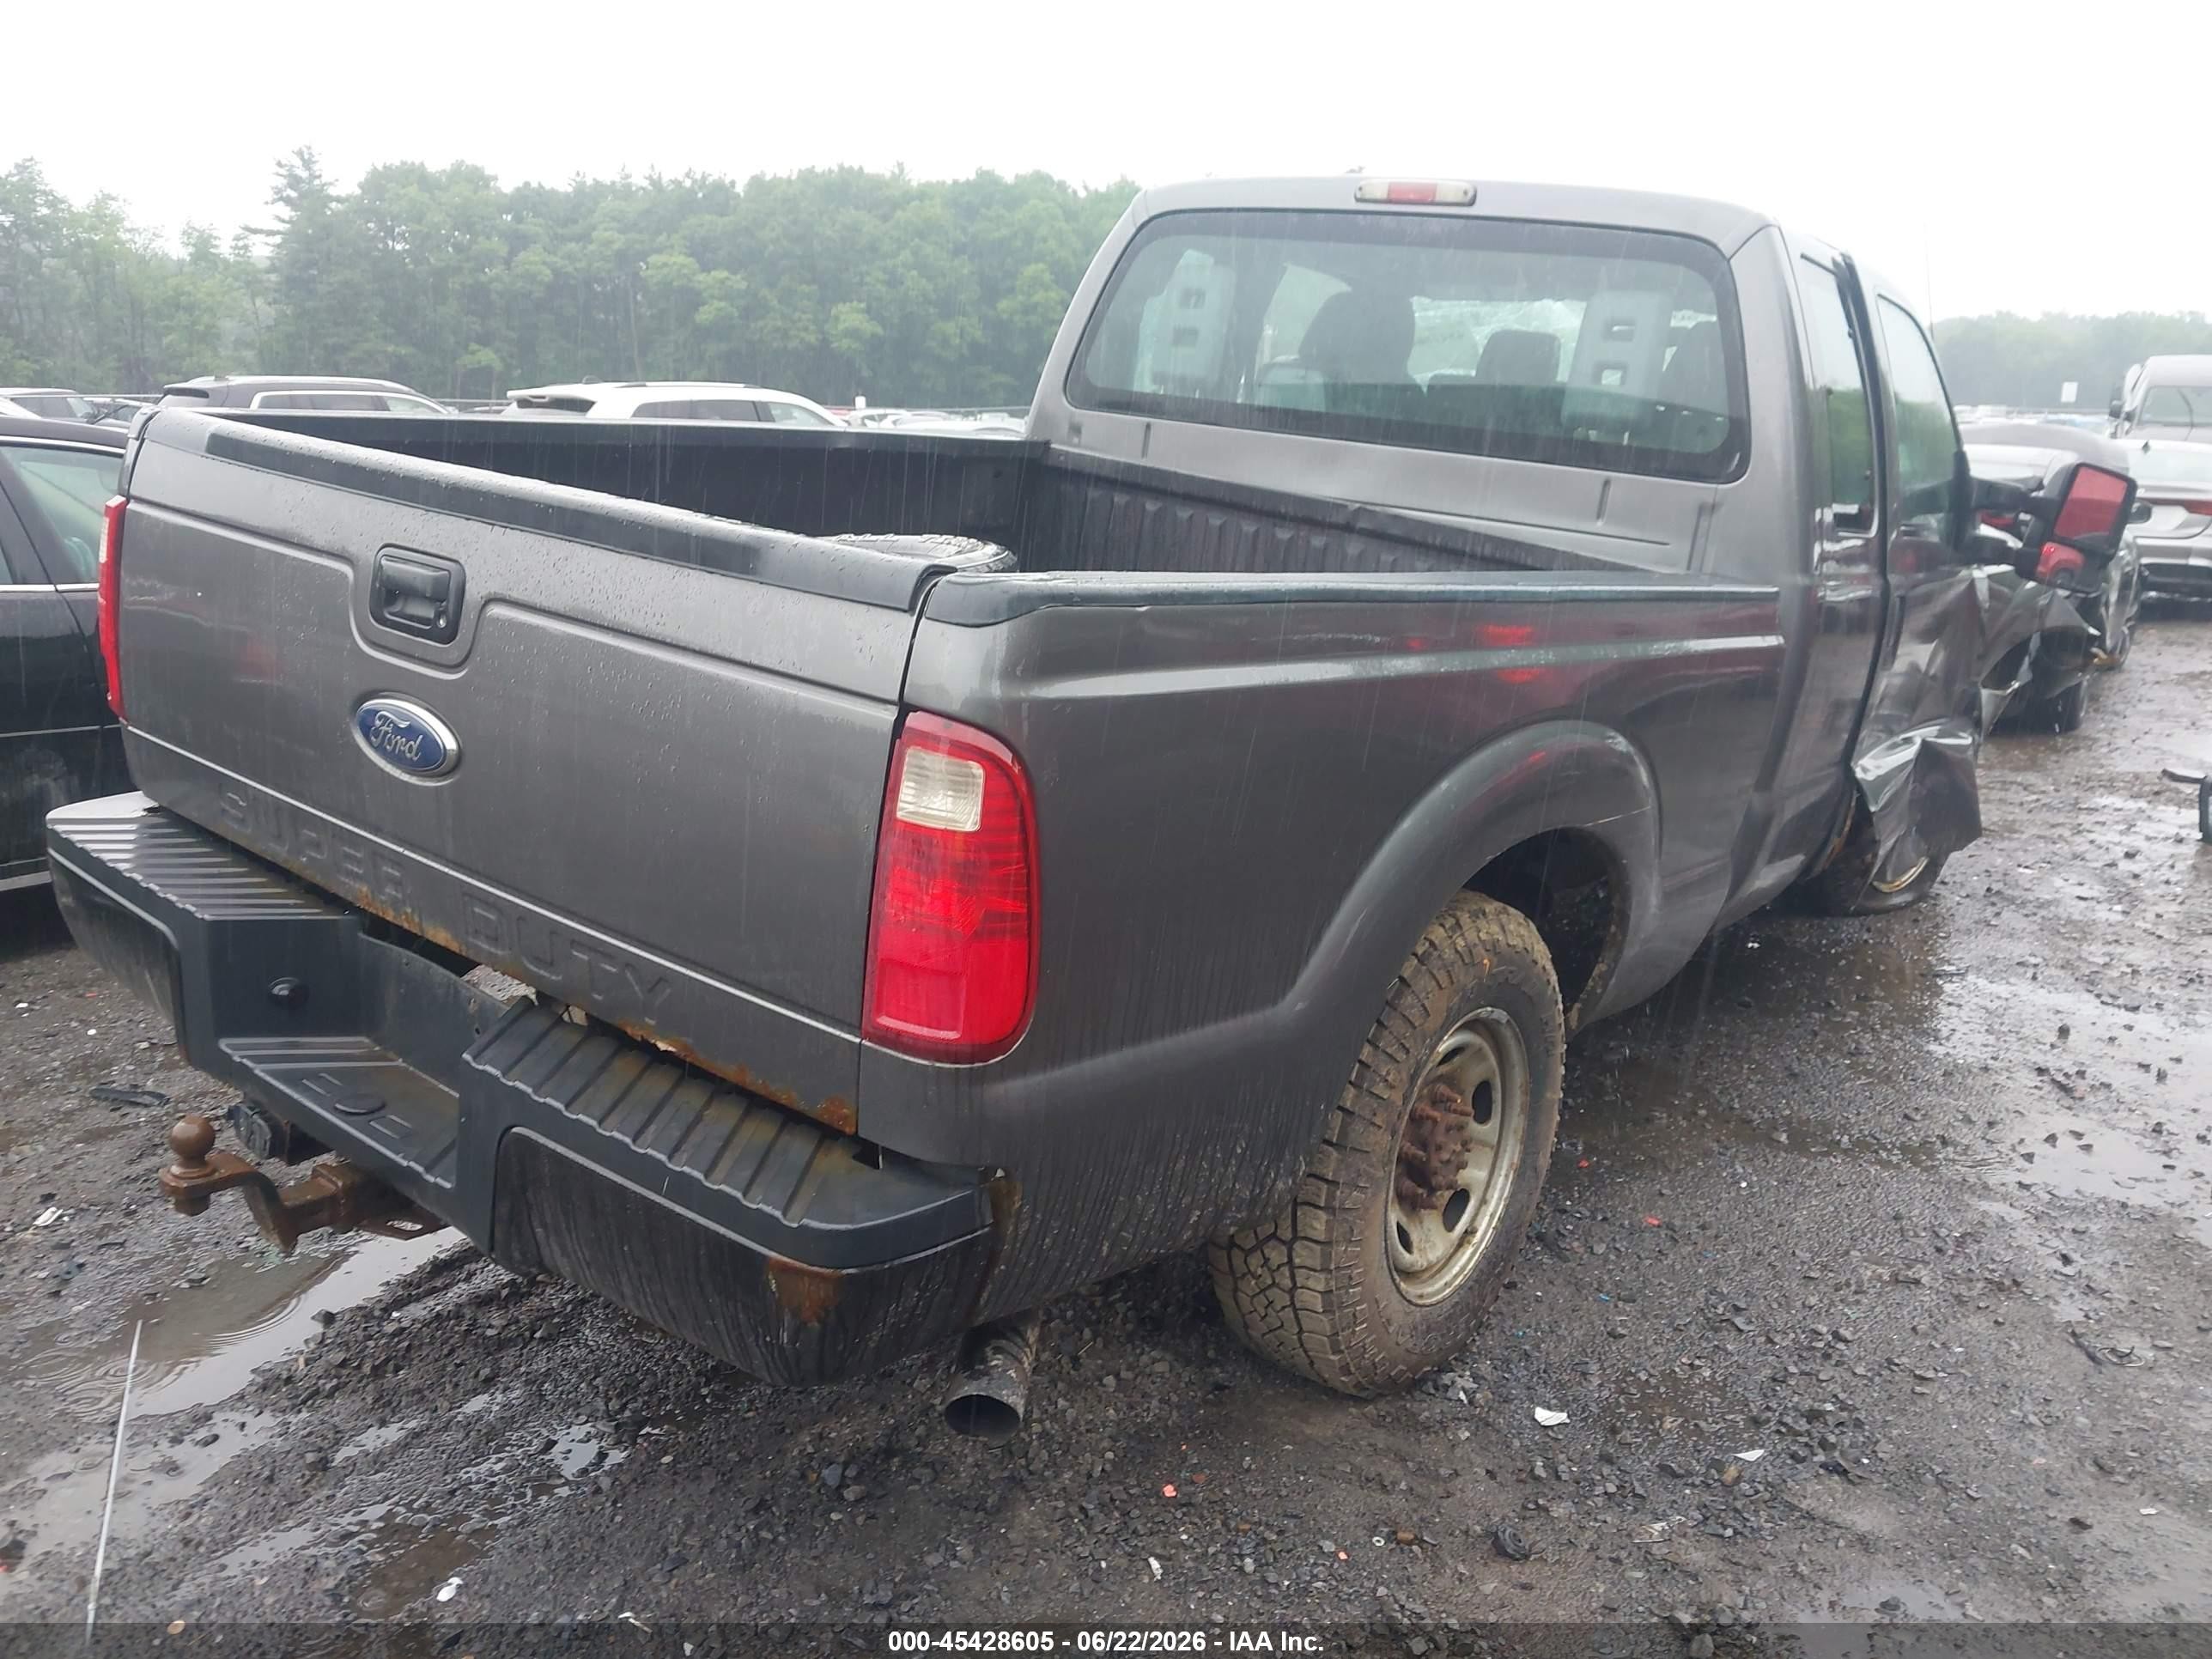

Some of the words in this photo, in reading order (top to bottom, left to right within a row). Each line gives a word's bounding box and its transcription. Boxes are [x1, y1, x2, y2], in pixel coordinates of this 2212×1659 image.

[369, 710, 424, 762] Ford
[218, 782, 412, 902] SUPER
[462, 890, 673, 1025] DUTY
